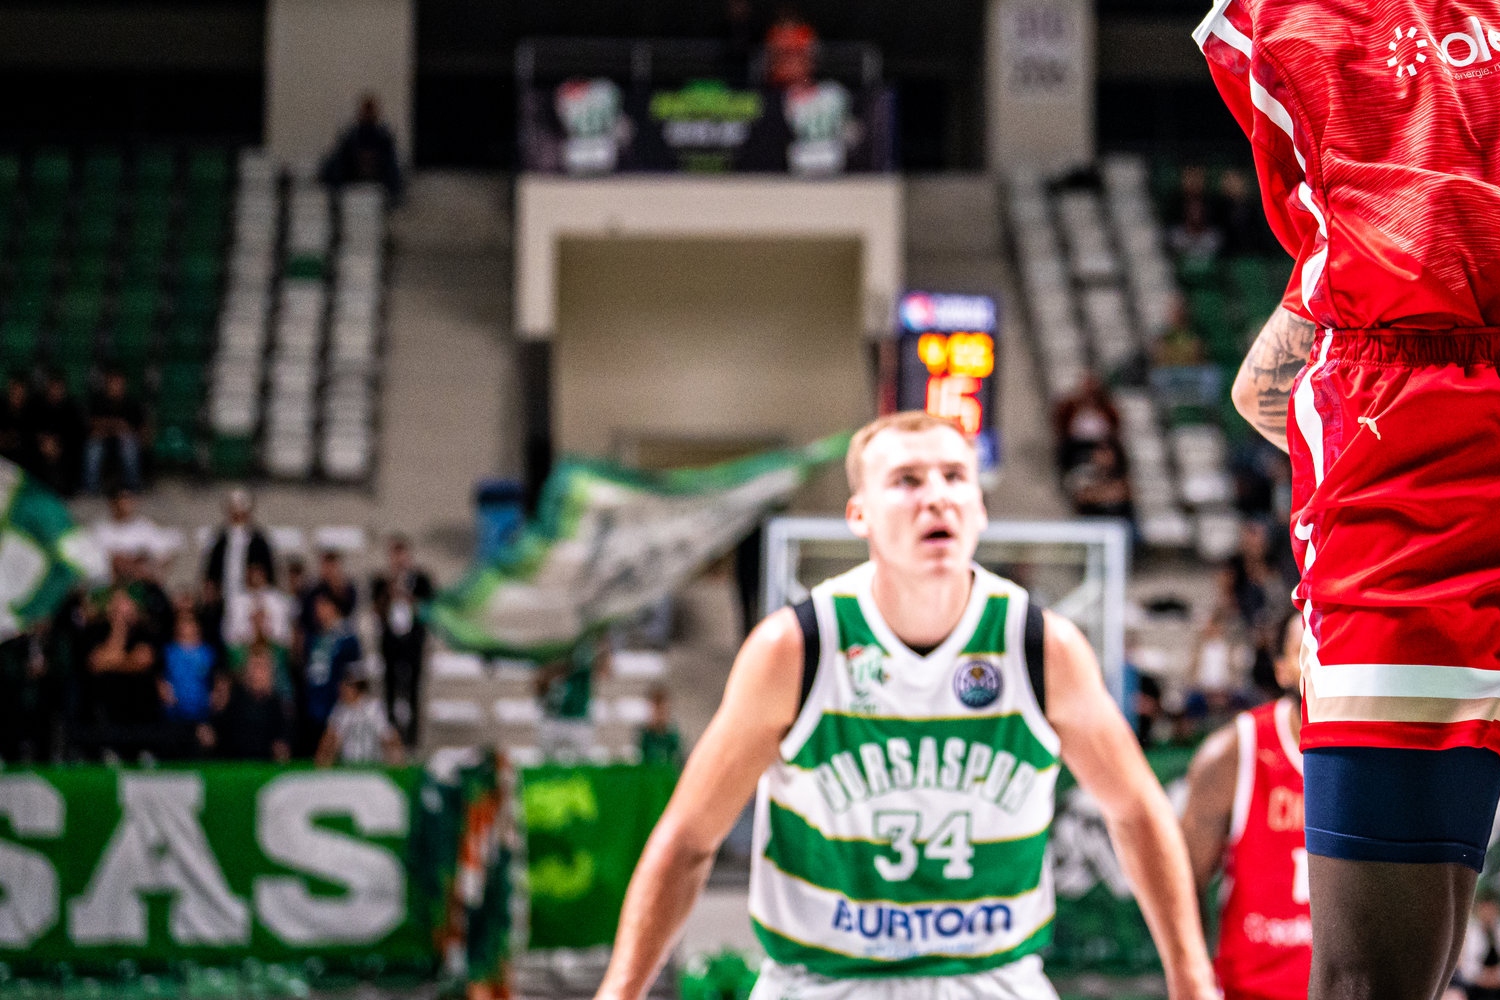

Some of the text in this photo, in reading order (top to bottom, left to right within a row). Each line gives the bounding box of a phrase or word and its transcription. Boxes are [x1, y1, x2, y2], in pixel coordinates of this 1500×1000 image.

[813, 736, 1039, 815] BURSASPOR
[873, 809, 975, 882] 34
[832, 898, 1013, 942] BURTOM
